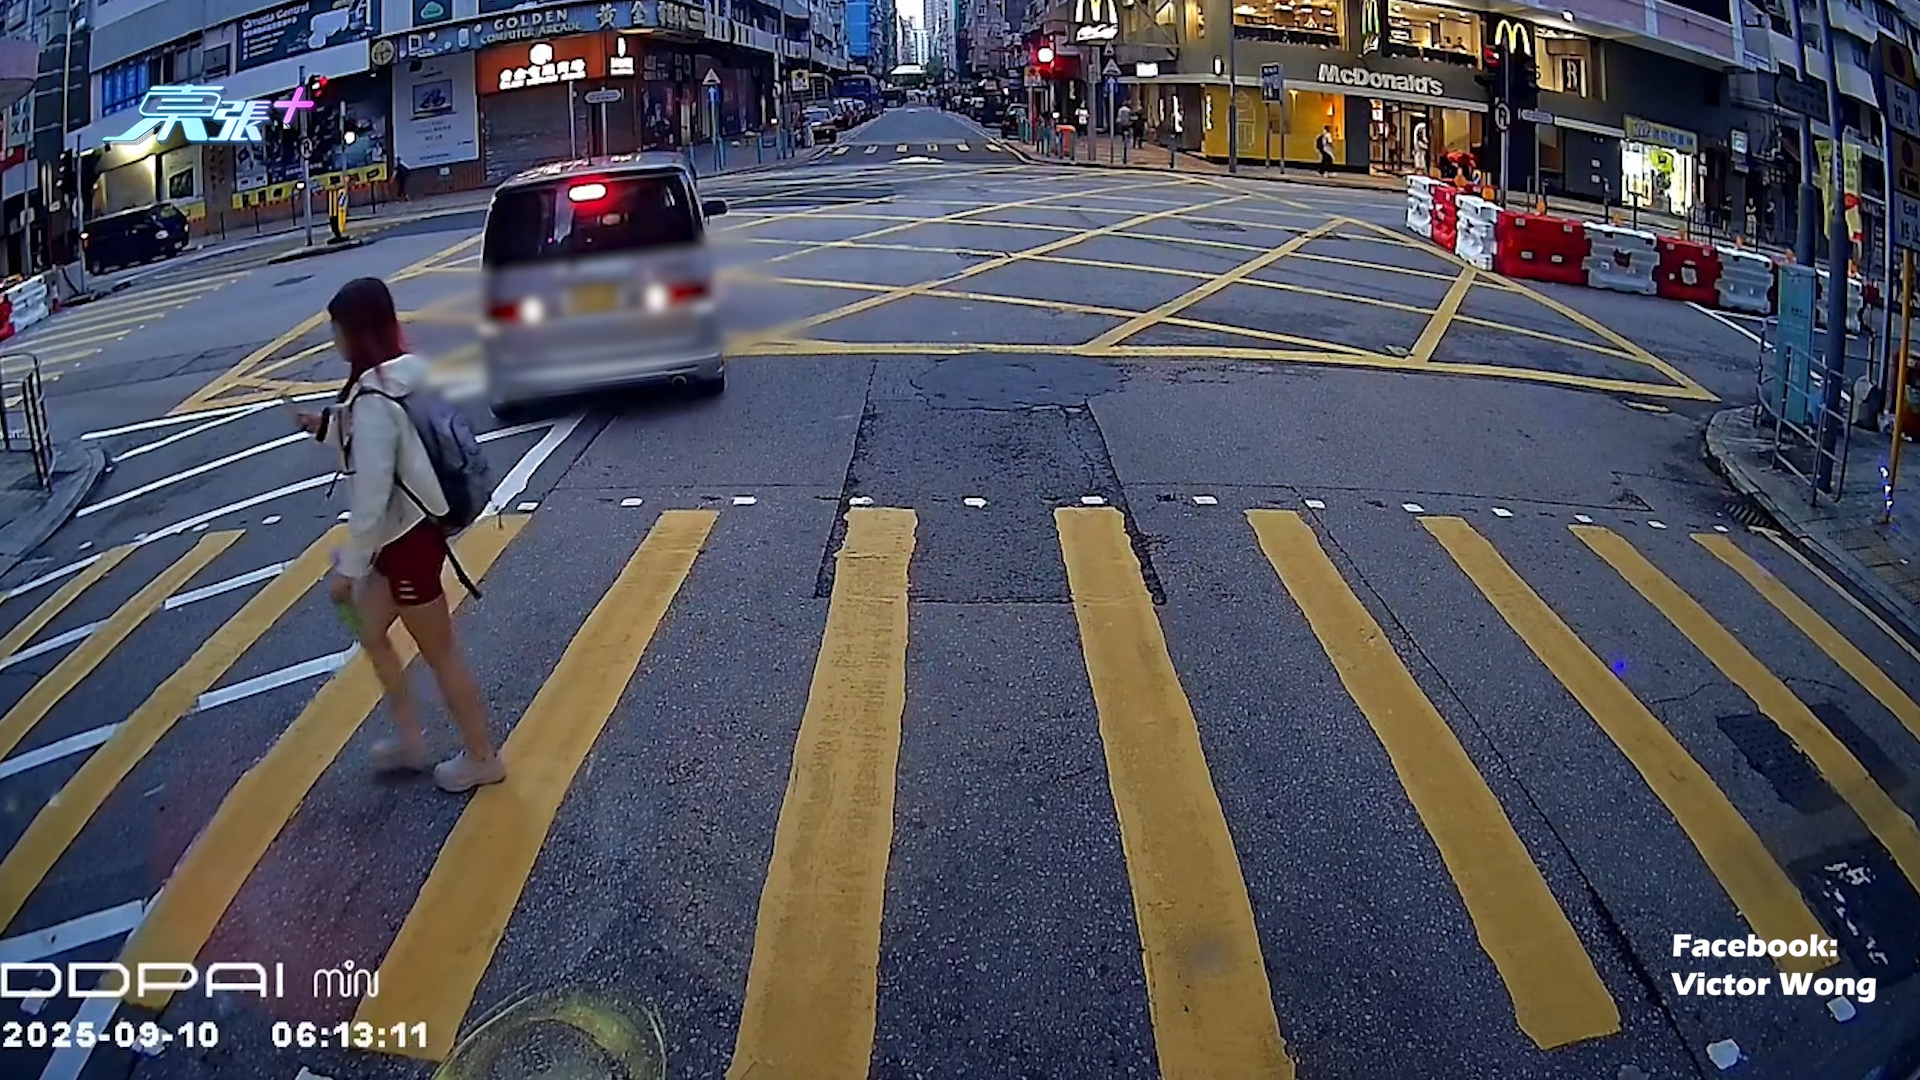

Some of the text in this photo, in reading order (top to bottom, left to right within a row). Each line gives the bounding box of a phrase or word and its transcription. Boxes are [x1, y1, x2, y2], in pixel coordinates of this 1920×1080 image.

[494, 9, 568, 31] GOLDEN
[538, 21, 582, 37] ARCADE
[1317, 63, 1444, 96] McDonald's
